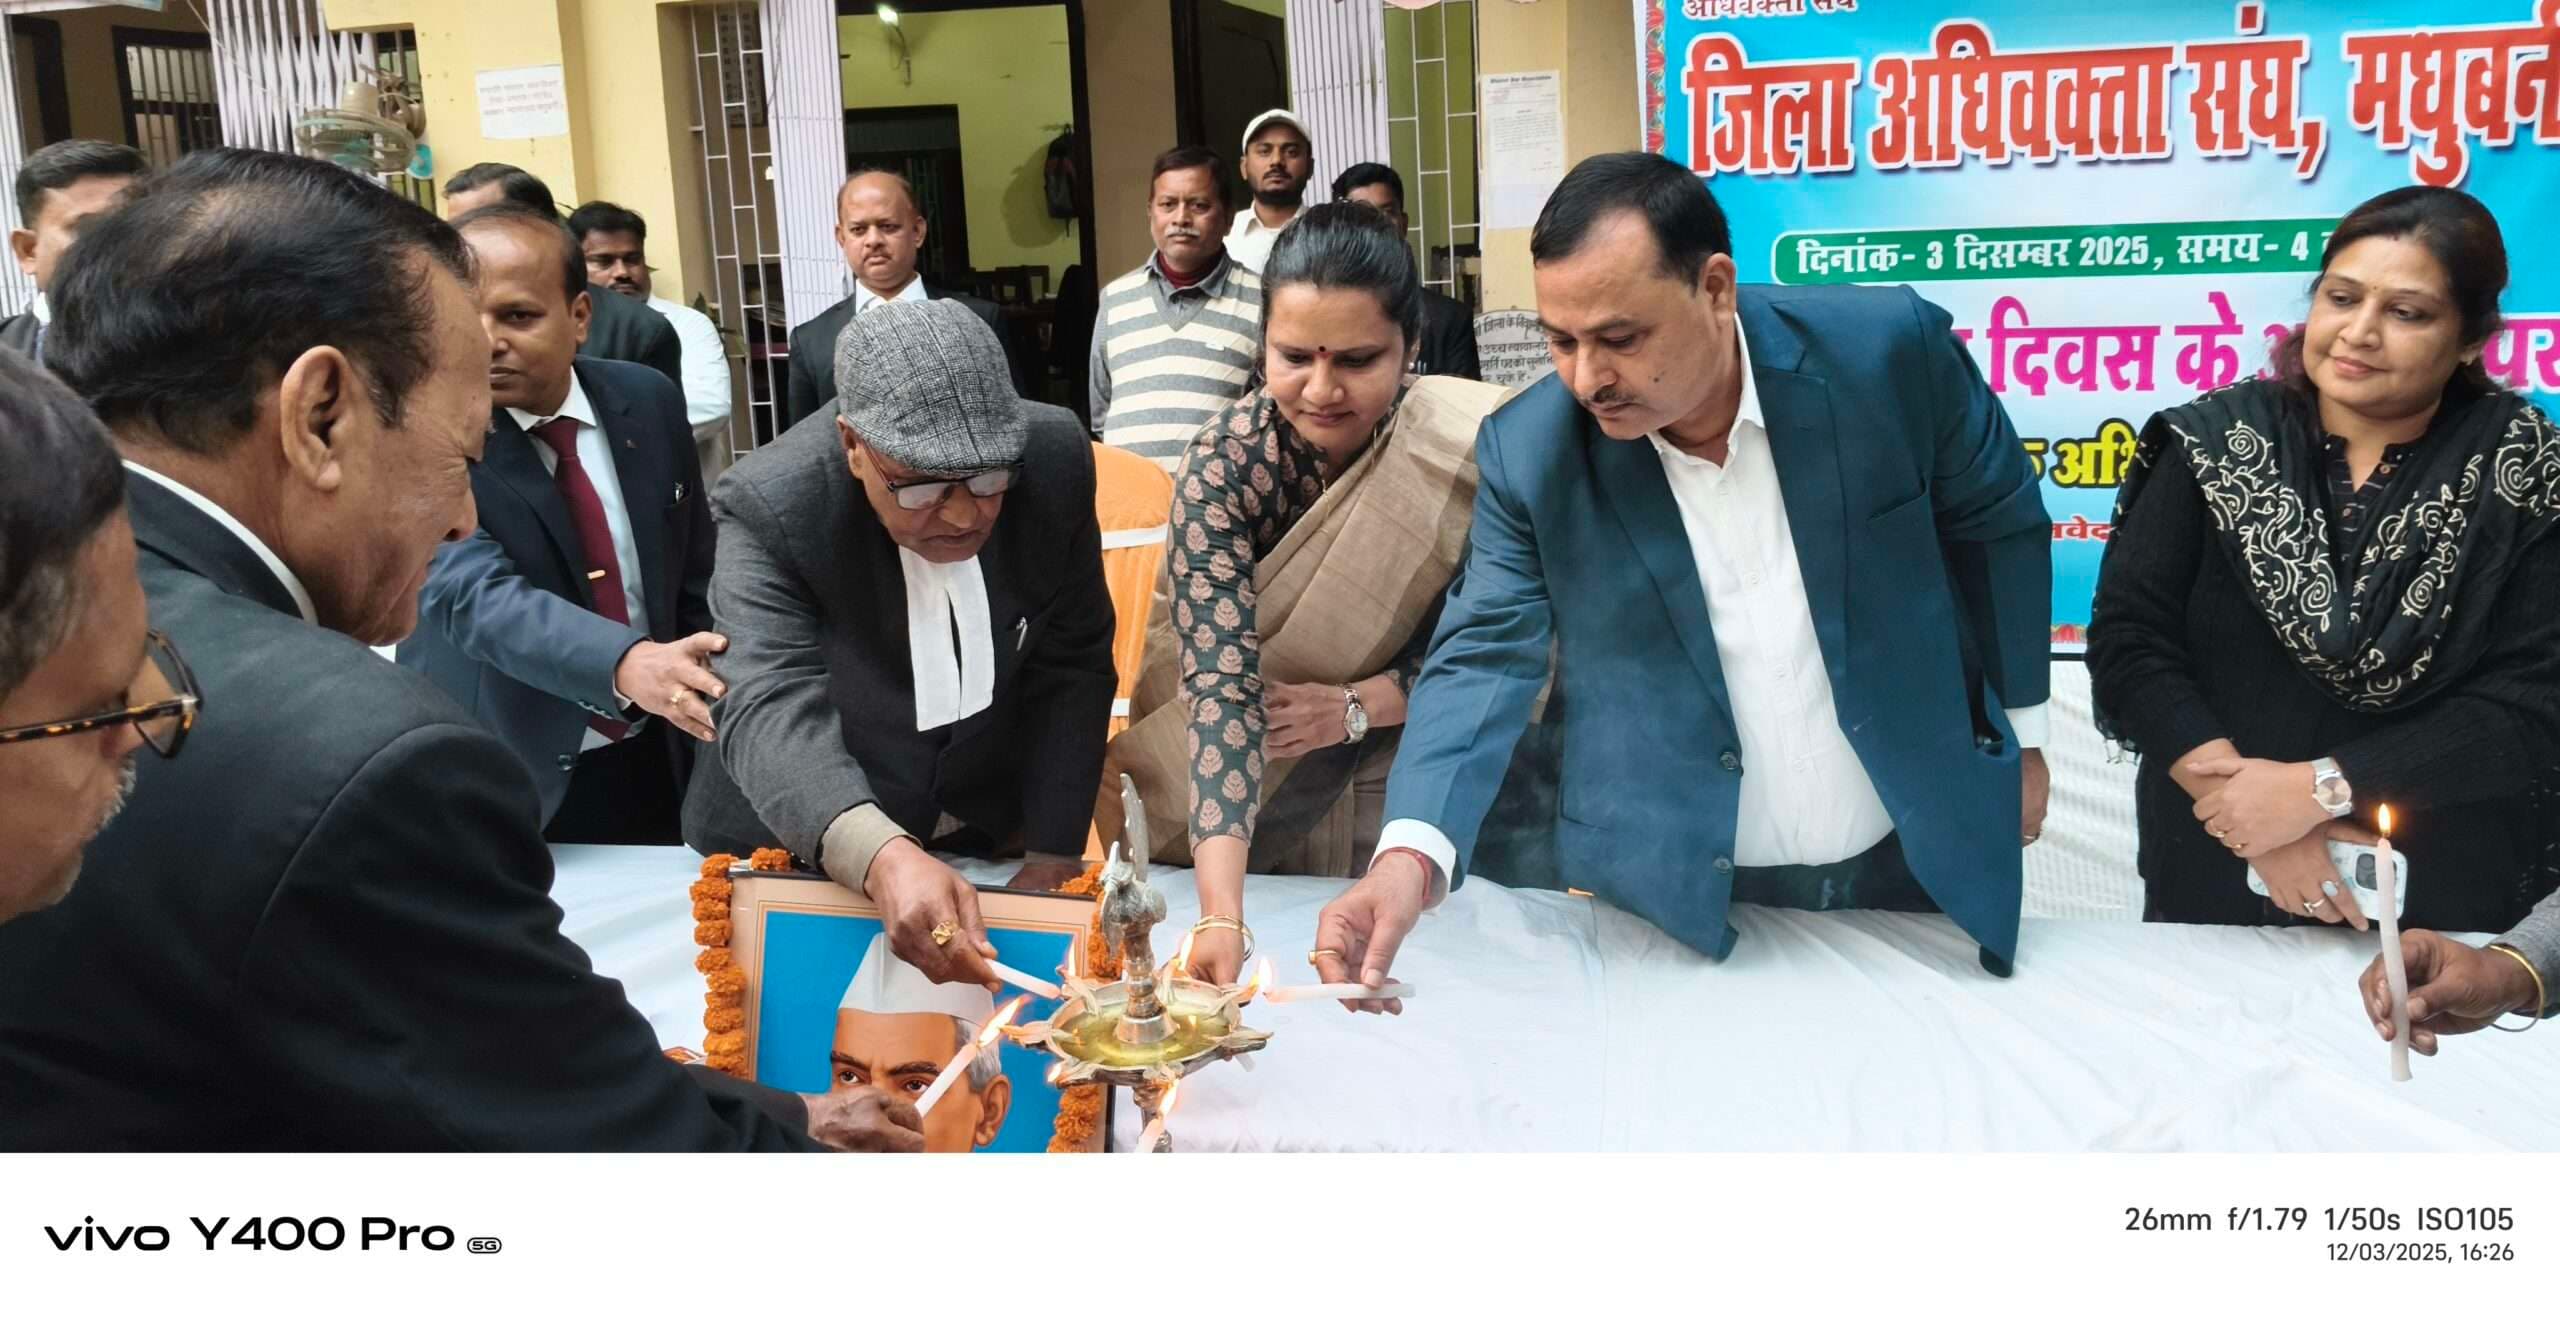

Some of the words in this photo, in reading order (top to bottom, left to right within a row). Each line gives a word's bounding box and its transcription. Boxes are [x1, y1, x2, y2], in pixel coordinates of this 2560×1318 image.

[1686, 38, 1855, 171] जिला
[1872, 24, 2175, 163] अधिवक्ता
[2186, 6, 2321, 173] संघ,
[2347, 0, 2560, 187] मधुबन
[1797, 237, 1916, 274] दिनांक-
[1926, 241, 1943, 269] 3
[1954, 235, 2072, 270] दिसम्बर
[2176, 233, 2279, 264] समय-
[2290, 232, 2309, 260] 4
[1987, 296, 2161, 395] दिवस
[2175, 291, 2243, 391] के
